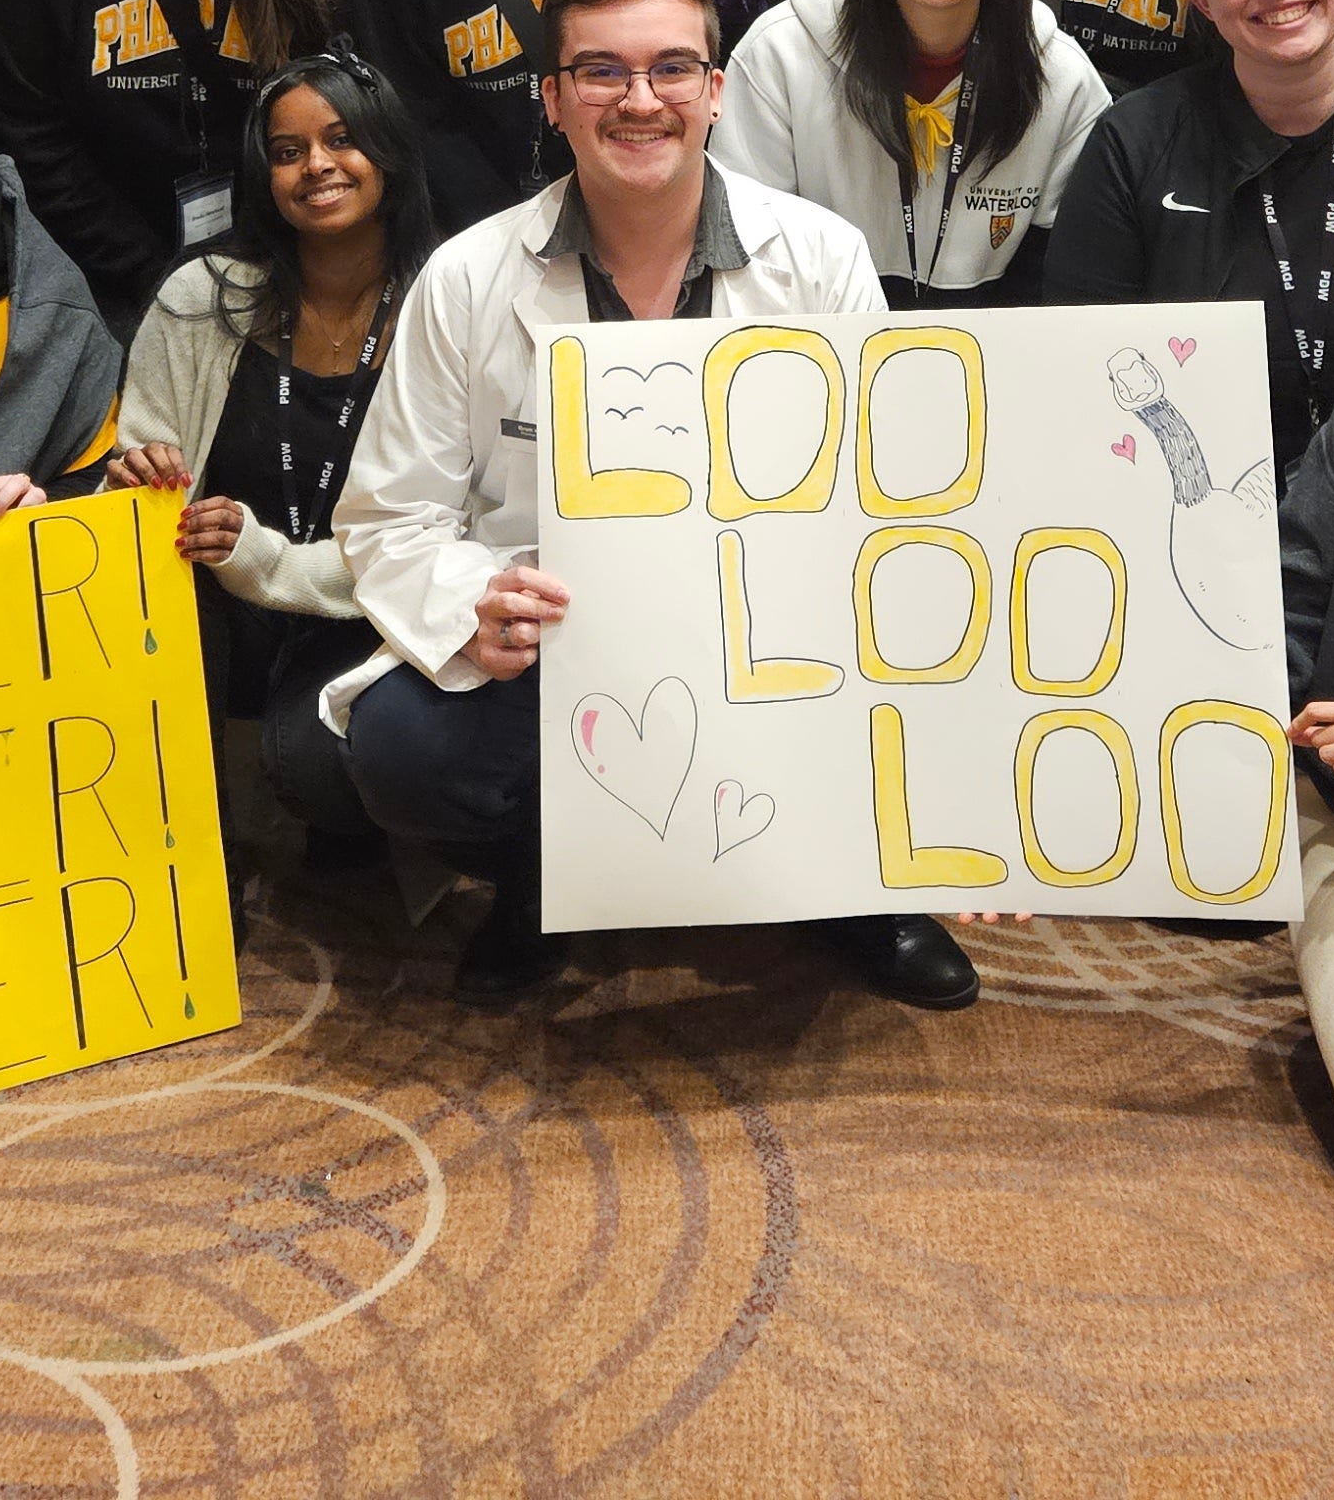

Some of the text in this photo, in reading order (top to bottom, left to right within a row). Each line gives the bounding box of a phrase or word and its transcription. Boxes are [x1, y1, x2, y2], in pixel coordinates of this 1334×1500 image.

[1082, 28, 1177, 52] OF WATERLOO
[107, 73, 180, 89] UNIVERSIT
[531, 74, 539, 99] PDW
[962, 79, 974, 108] PDW
[951, 144, 963, 174] PDW
[903, 205, 913, 234] PDW
[1263, 194, 1277, 224] PDW
[1278, 260, 1295, 291] PDW
[1318, 270, 1331, 301] PDW
[361, 336, 376, 364] PDW
[1295, 329, 1310, 359] PDW
[1313, 340, 1324, 369] PDW
[279, 376, 289, 404] PDW
[338, 398, 354, 428] PDW
[549, 325, 988, 522] LOO
[282, 443, 293, 471] PDW
[319, 462, 334, 490] PDW
[289, 507, 300, 535] PDW
[716, 525, 1128, 705] LOO
[870, 699, 1291, 905] LOO
